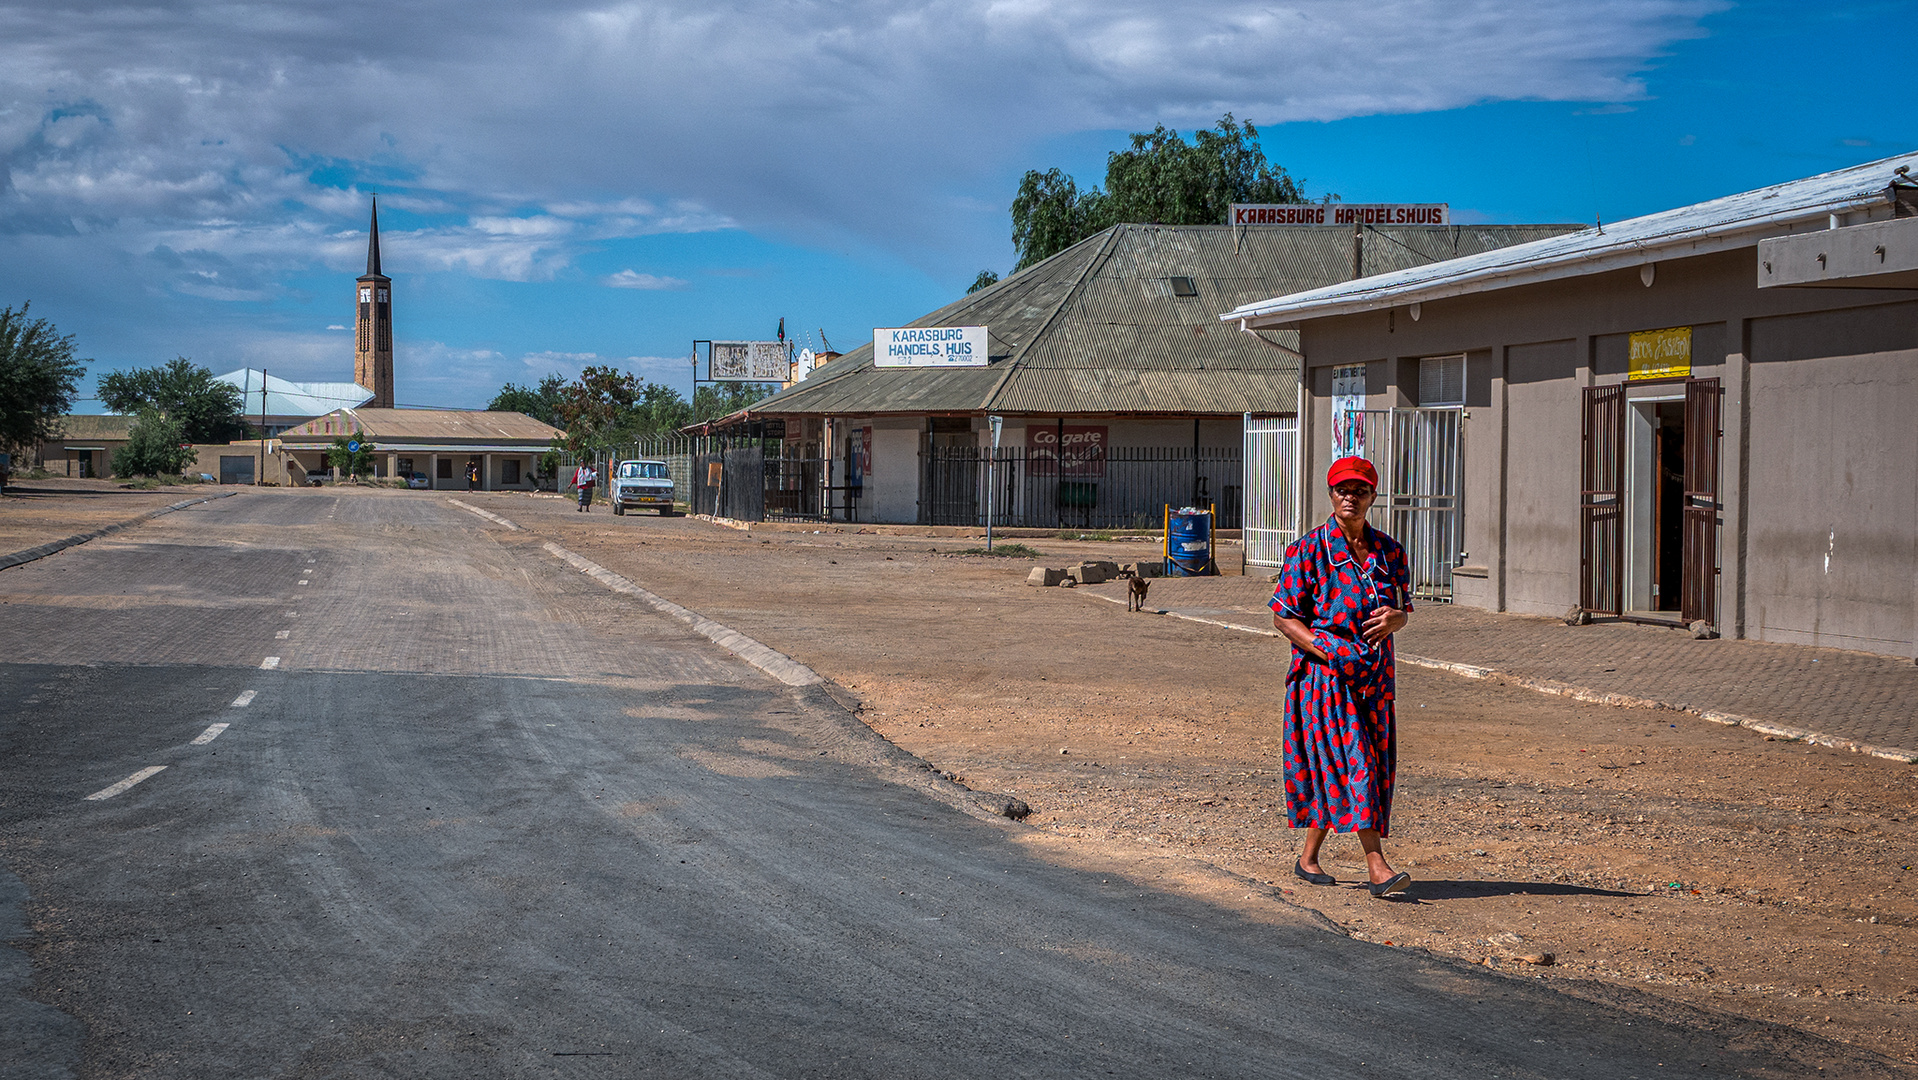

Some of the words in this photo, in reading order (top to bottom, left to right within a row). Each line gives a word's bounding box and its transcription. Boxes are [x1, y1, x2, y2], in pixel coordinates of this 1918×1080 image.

[1235, 207, 1325, 224] KARASBURG
[1334, 207, 1443, 224] HANDELSHUIS
[892, 328, 963, 342] KARASBURG
[888, 343, 940, 356] HANDELS
[946, 342, 972, 355] HUIS
[907, 356, 912, 364] 2
[1033, 431, 1101, 447] Cogate
